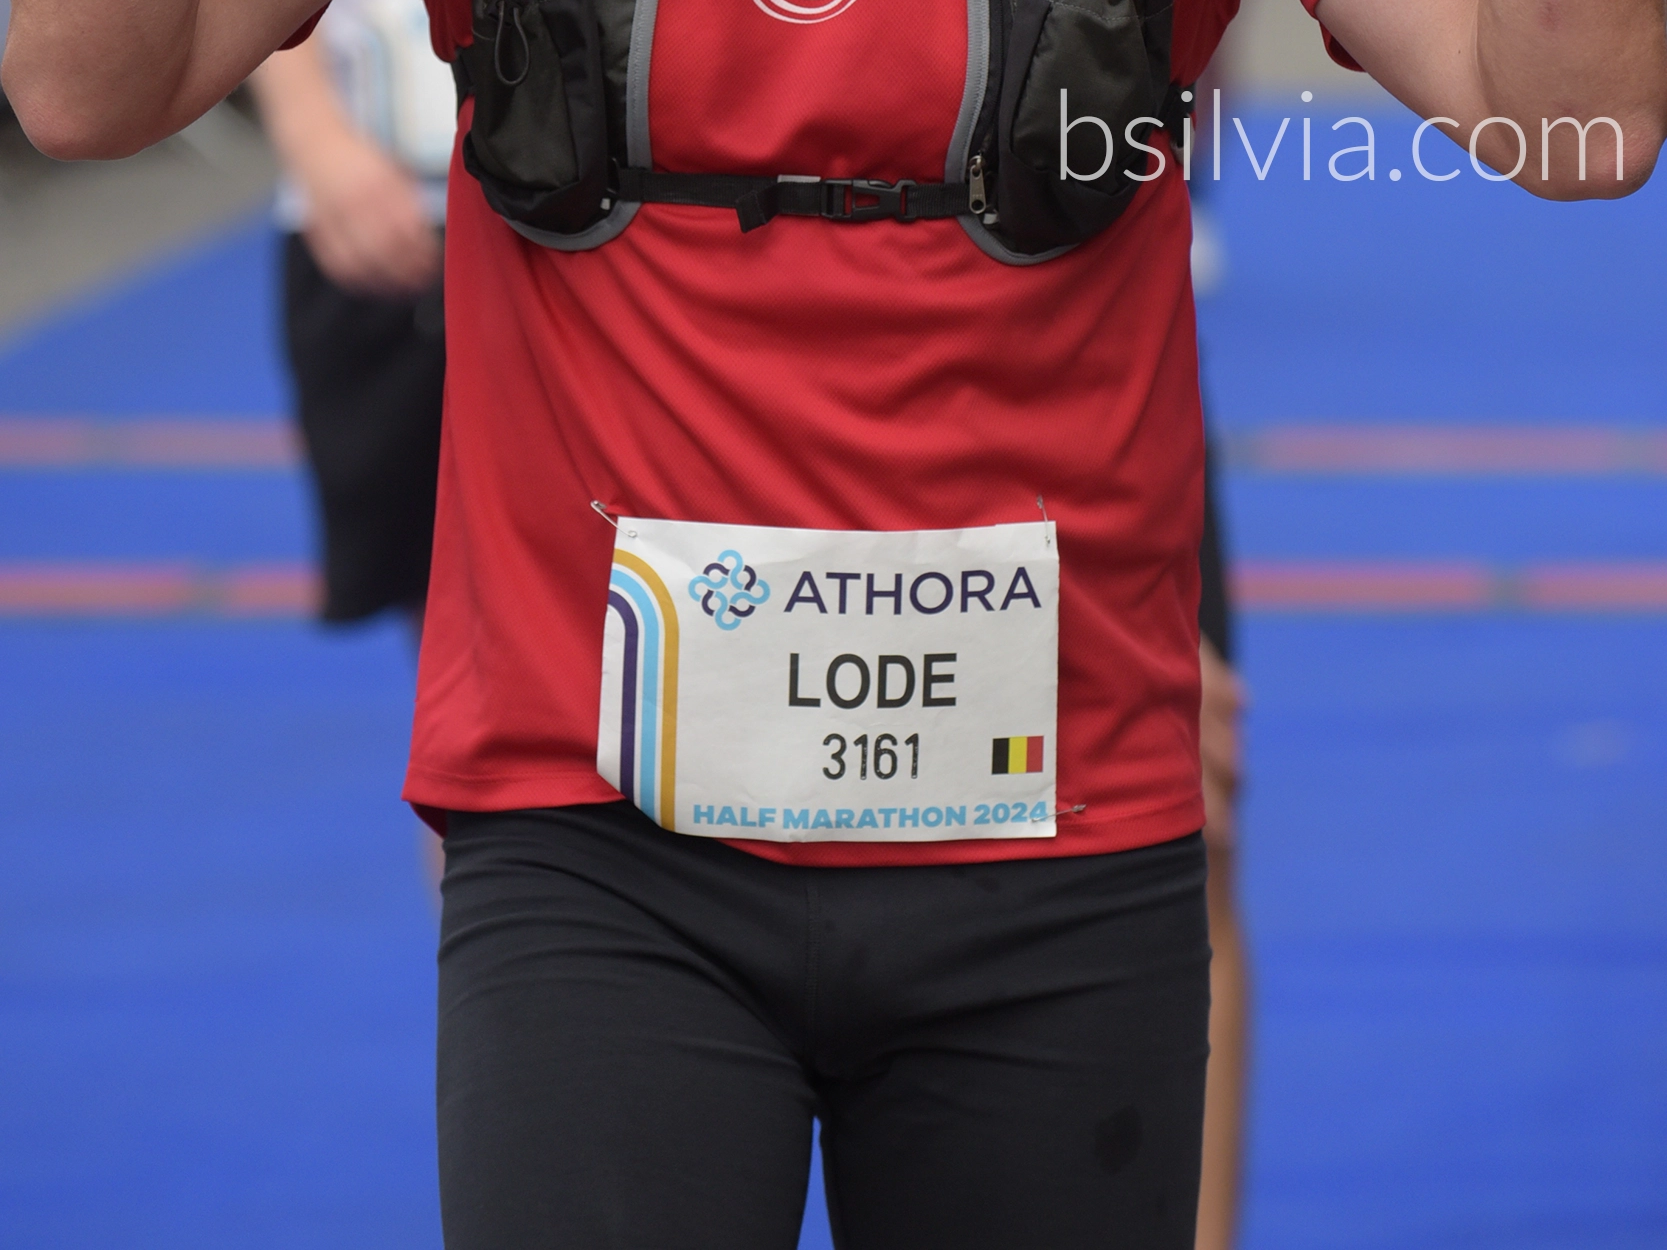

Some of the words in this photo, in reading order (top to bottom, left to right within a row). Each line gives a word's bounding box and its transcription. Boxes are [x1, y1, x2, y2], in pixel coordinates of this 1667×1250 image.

[784, 565, 1042, 615] ATHORA
[788, 652, 958, 709] LODE
[822, 732, 919, 780] 3161
[693, 804, 777, 829] HALF
[783, 804, 966, 830] MARATHON
[974, 801, 1047, 825] 2024
